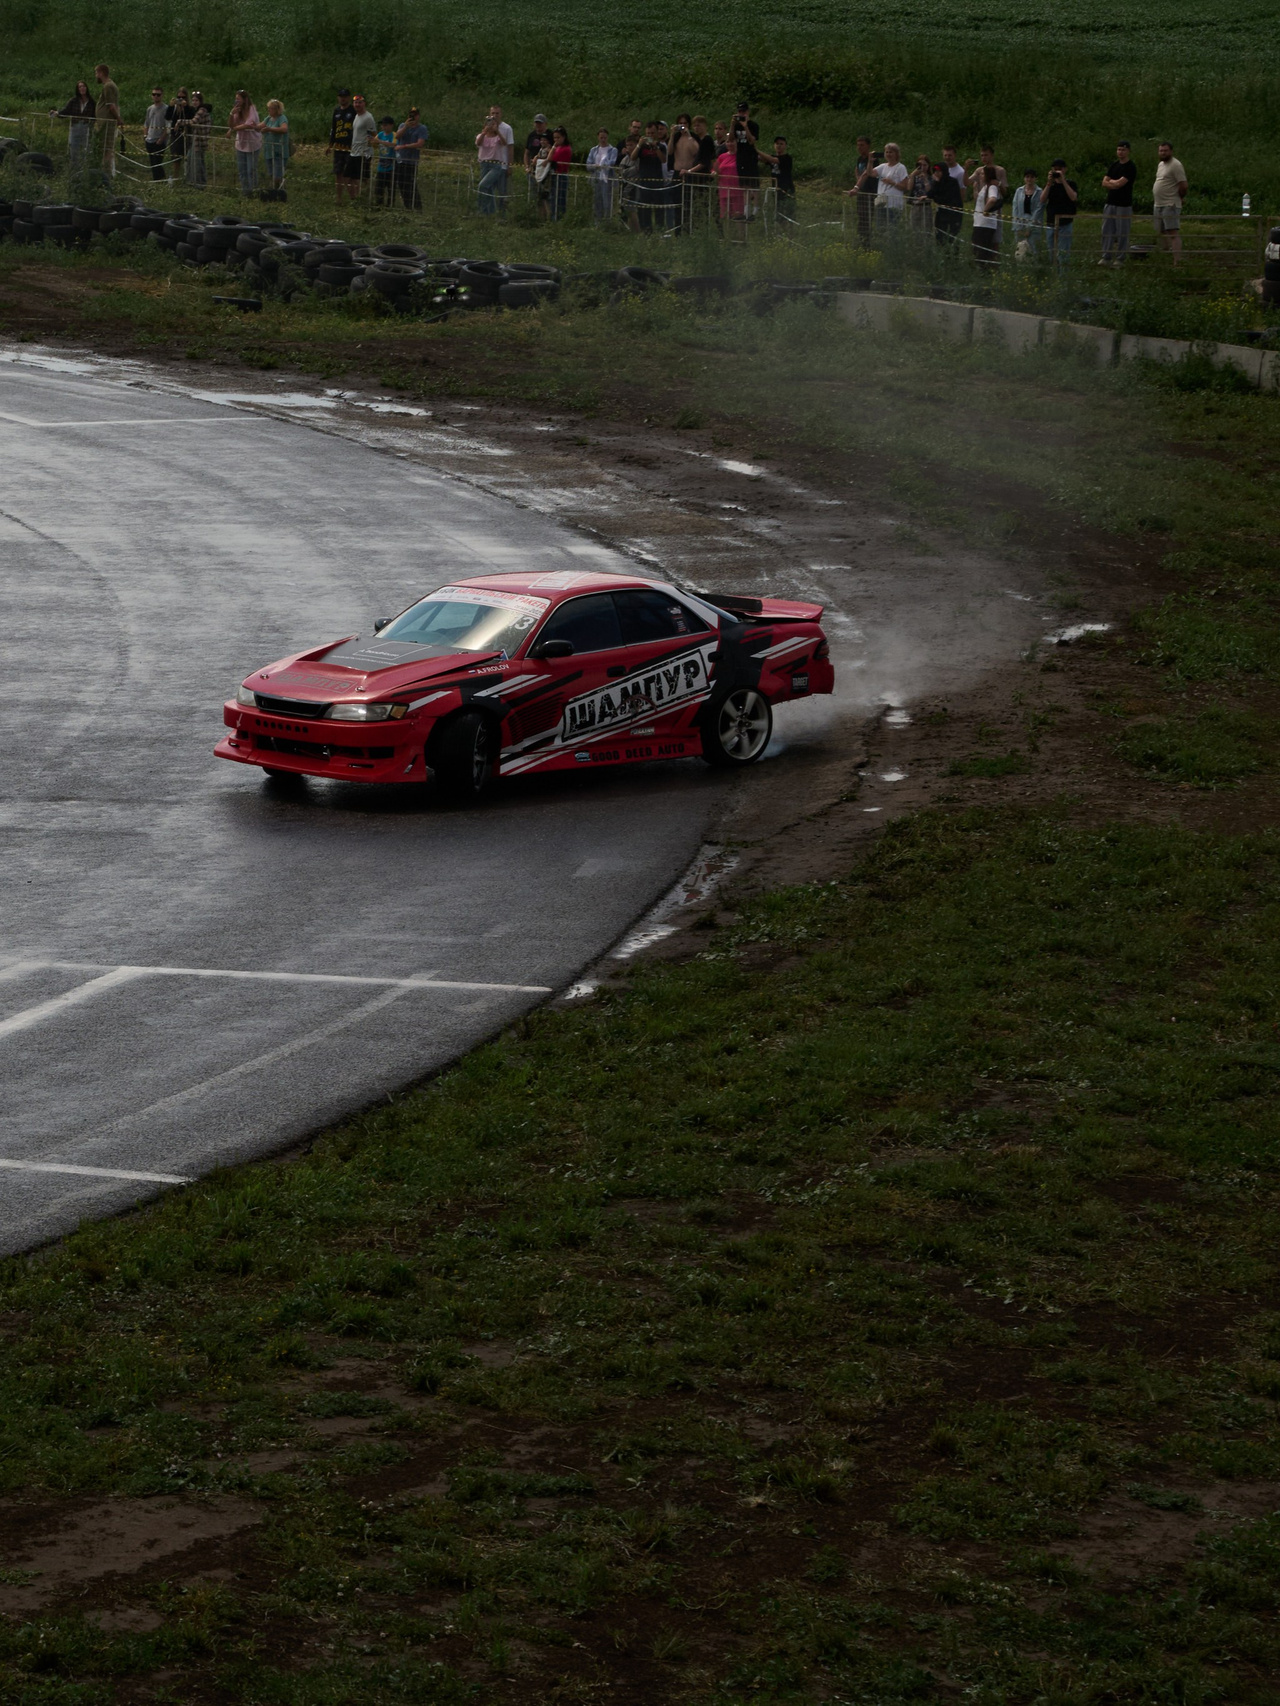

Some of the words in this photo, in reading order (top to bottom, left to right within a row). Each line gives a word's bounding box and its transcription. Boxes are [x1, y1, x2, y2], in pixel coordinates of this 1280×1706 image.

[509, 614, 535, 630] 13
[568, 658, 701, 735] ШАМПУР
[591, 750, 620, 762] GOOD
[625, 746, 652, 759] DEED
[658, 742, 685, 756] AUTO
